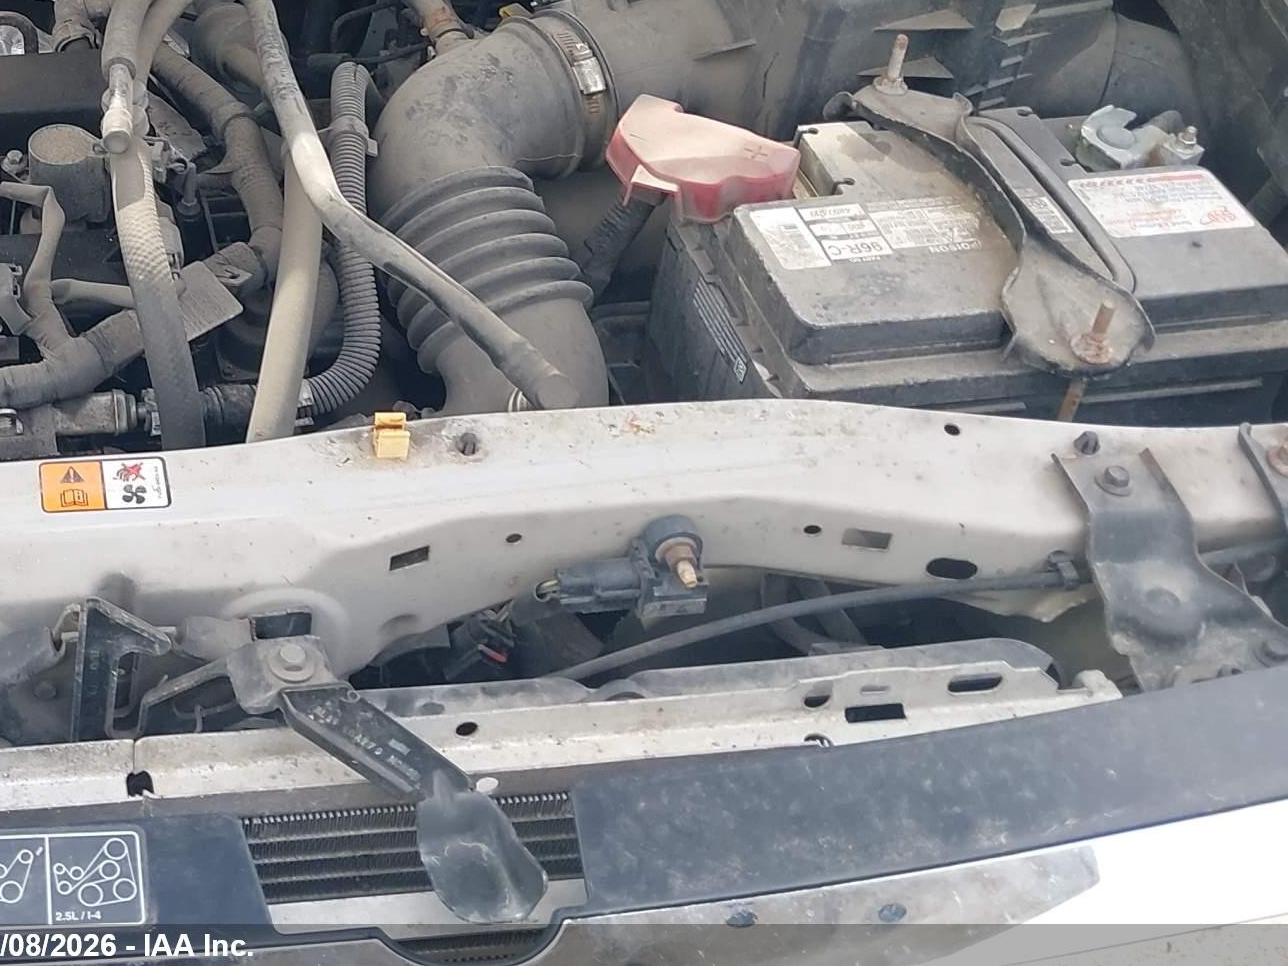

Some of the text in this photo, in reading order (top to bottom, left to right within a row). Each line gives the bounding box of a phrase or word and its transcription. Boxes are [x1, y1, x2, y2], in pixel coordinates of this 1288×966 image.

[827, 242, 883, 257] 96R-C
[55, 912, 79, 922] 2.5L
[86, 911, 102, 921] I-4
